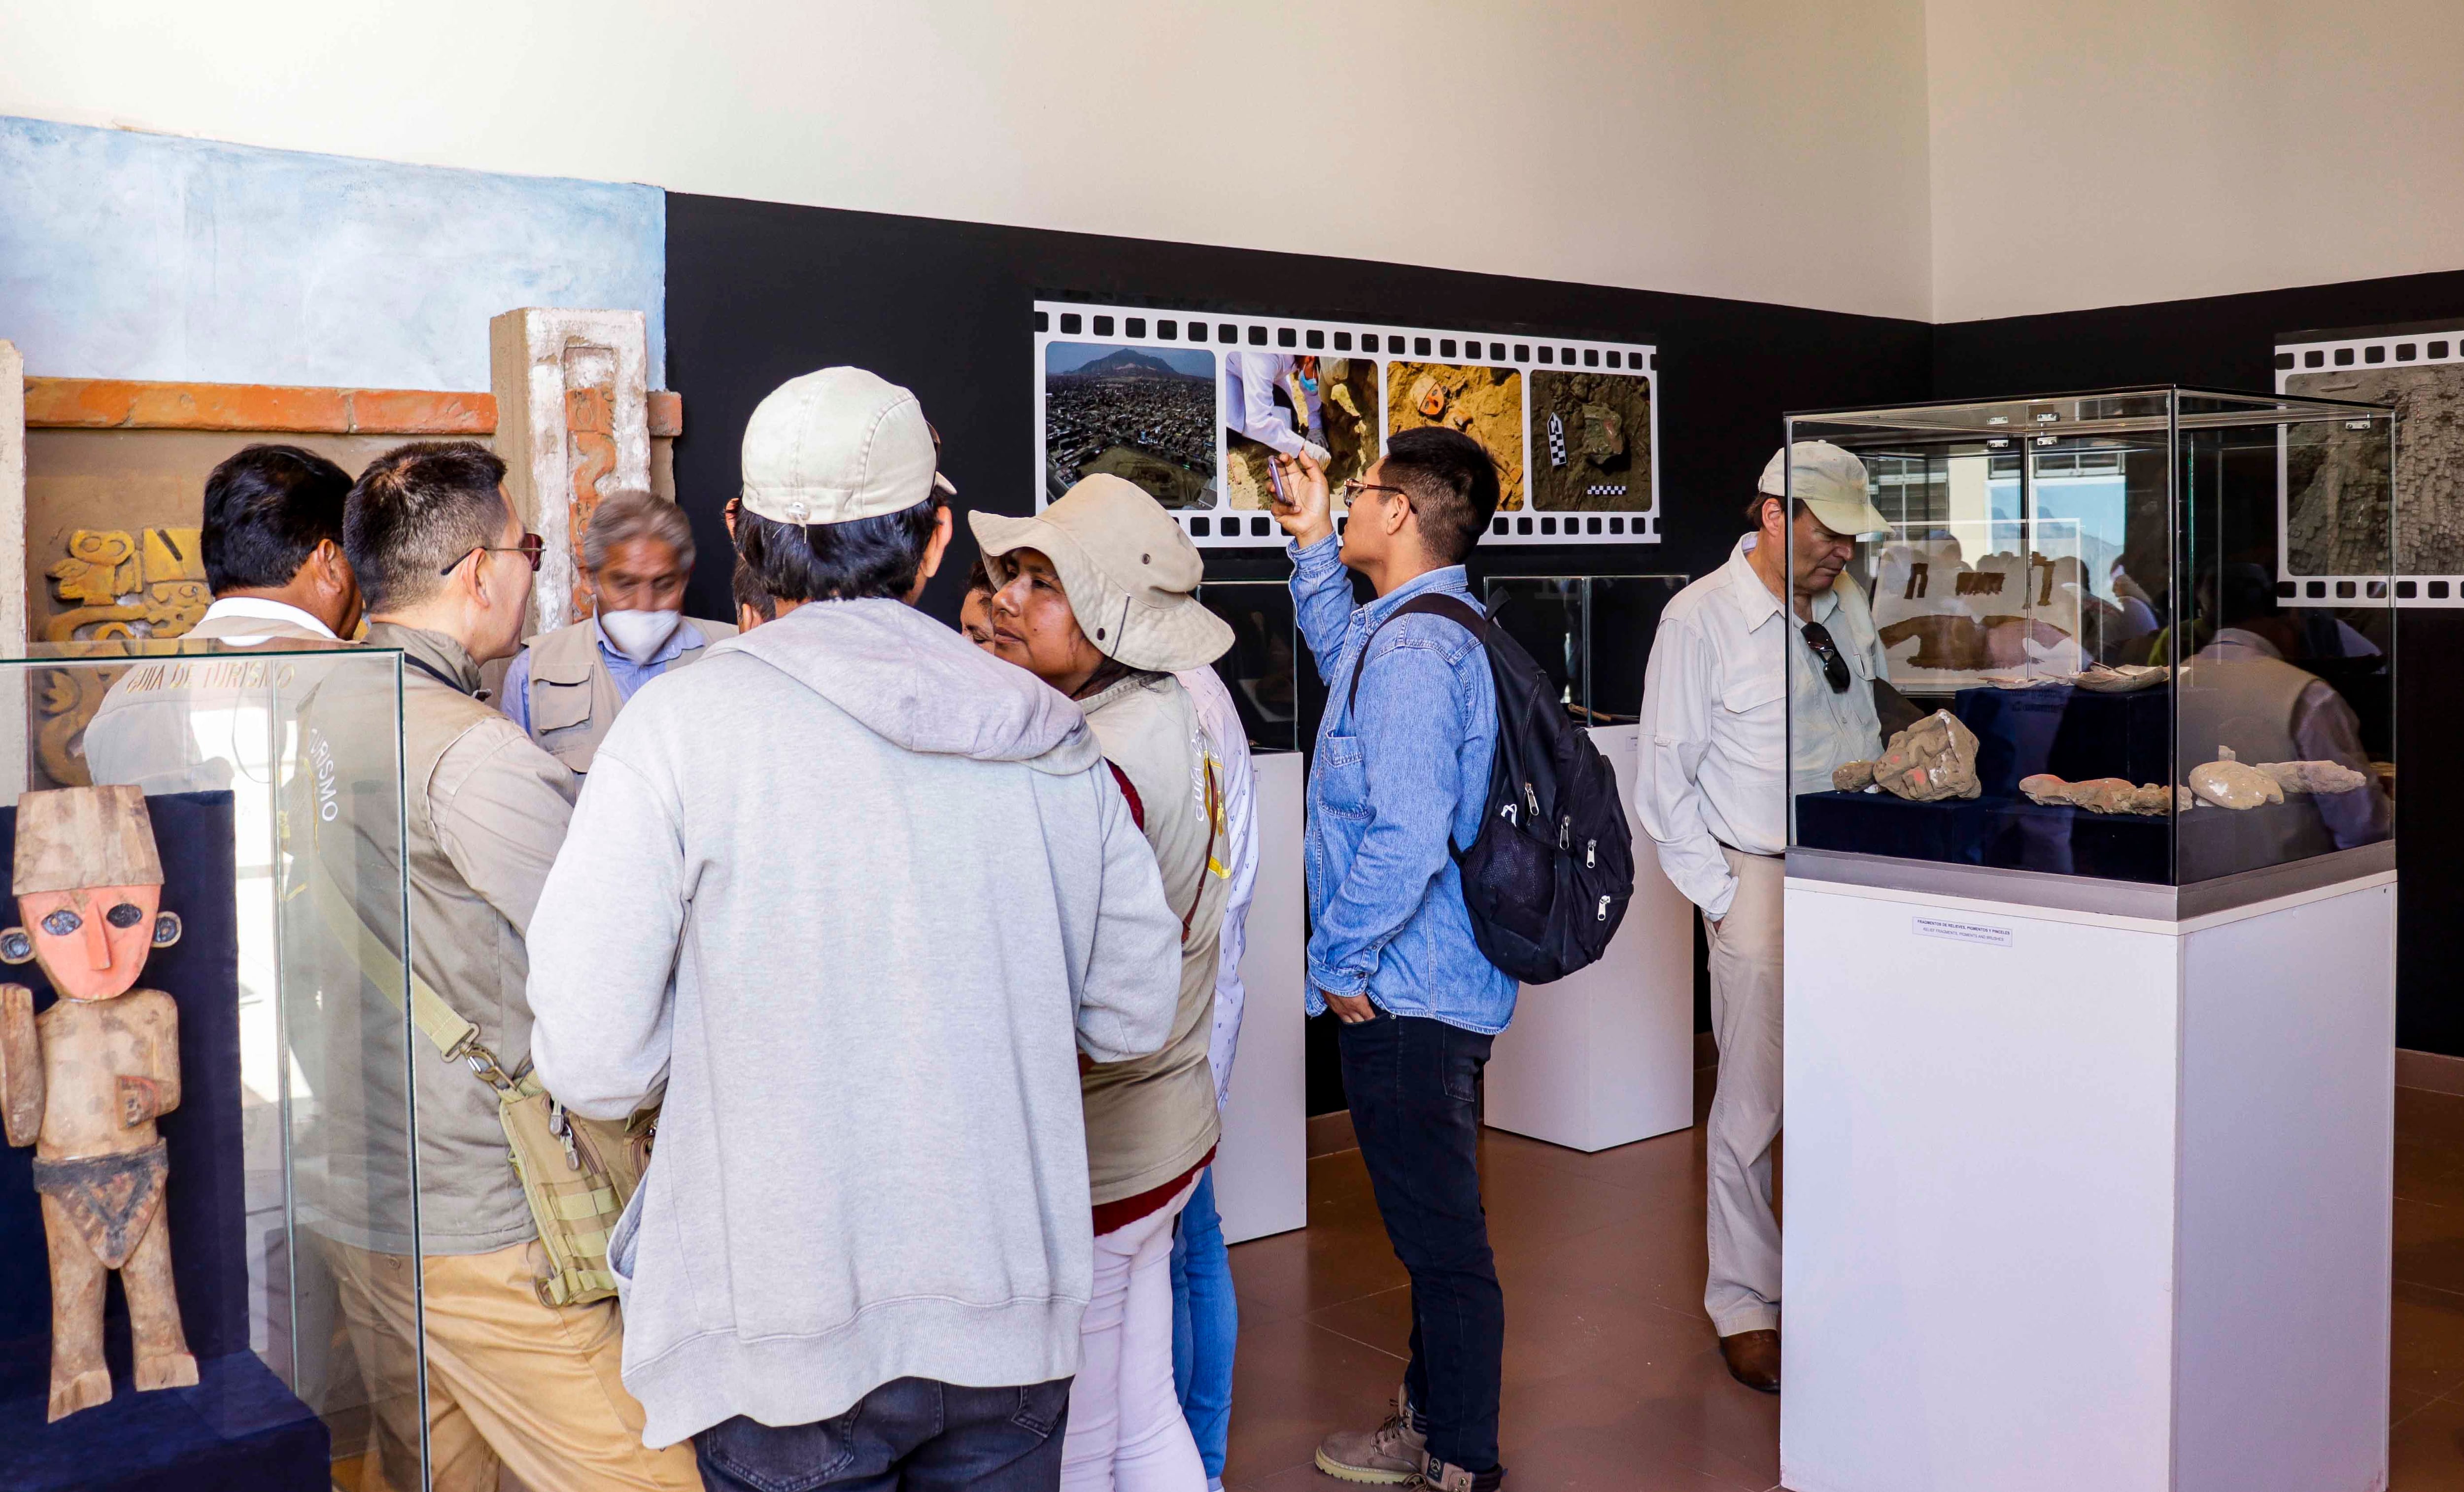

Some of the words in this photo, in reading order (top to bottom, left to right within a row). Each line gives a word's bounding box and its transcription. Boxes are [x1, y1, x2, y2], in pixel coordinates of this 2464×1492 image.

[127, 664, 166, 694] GUIA
[170, 662, 198, 689] DE
[203, 659, 295, 689] TURISMO
[1190, 766, 1204, 822] GUIA
